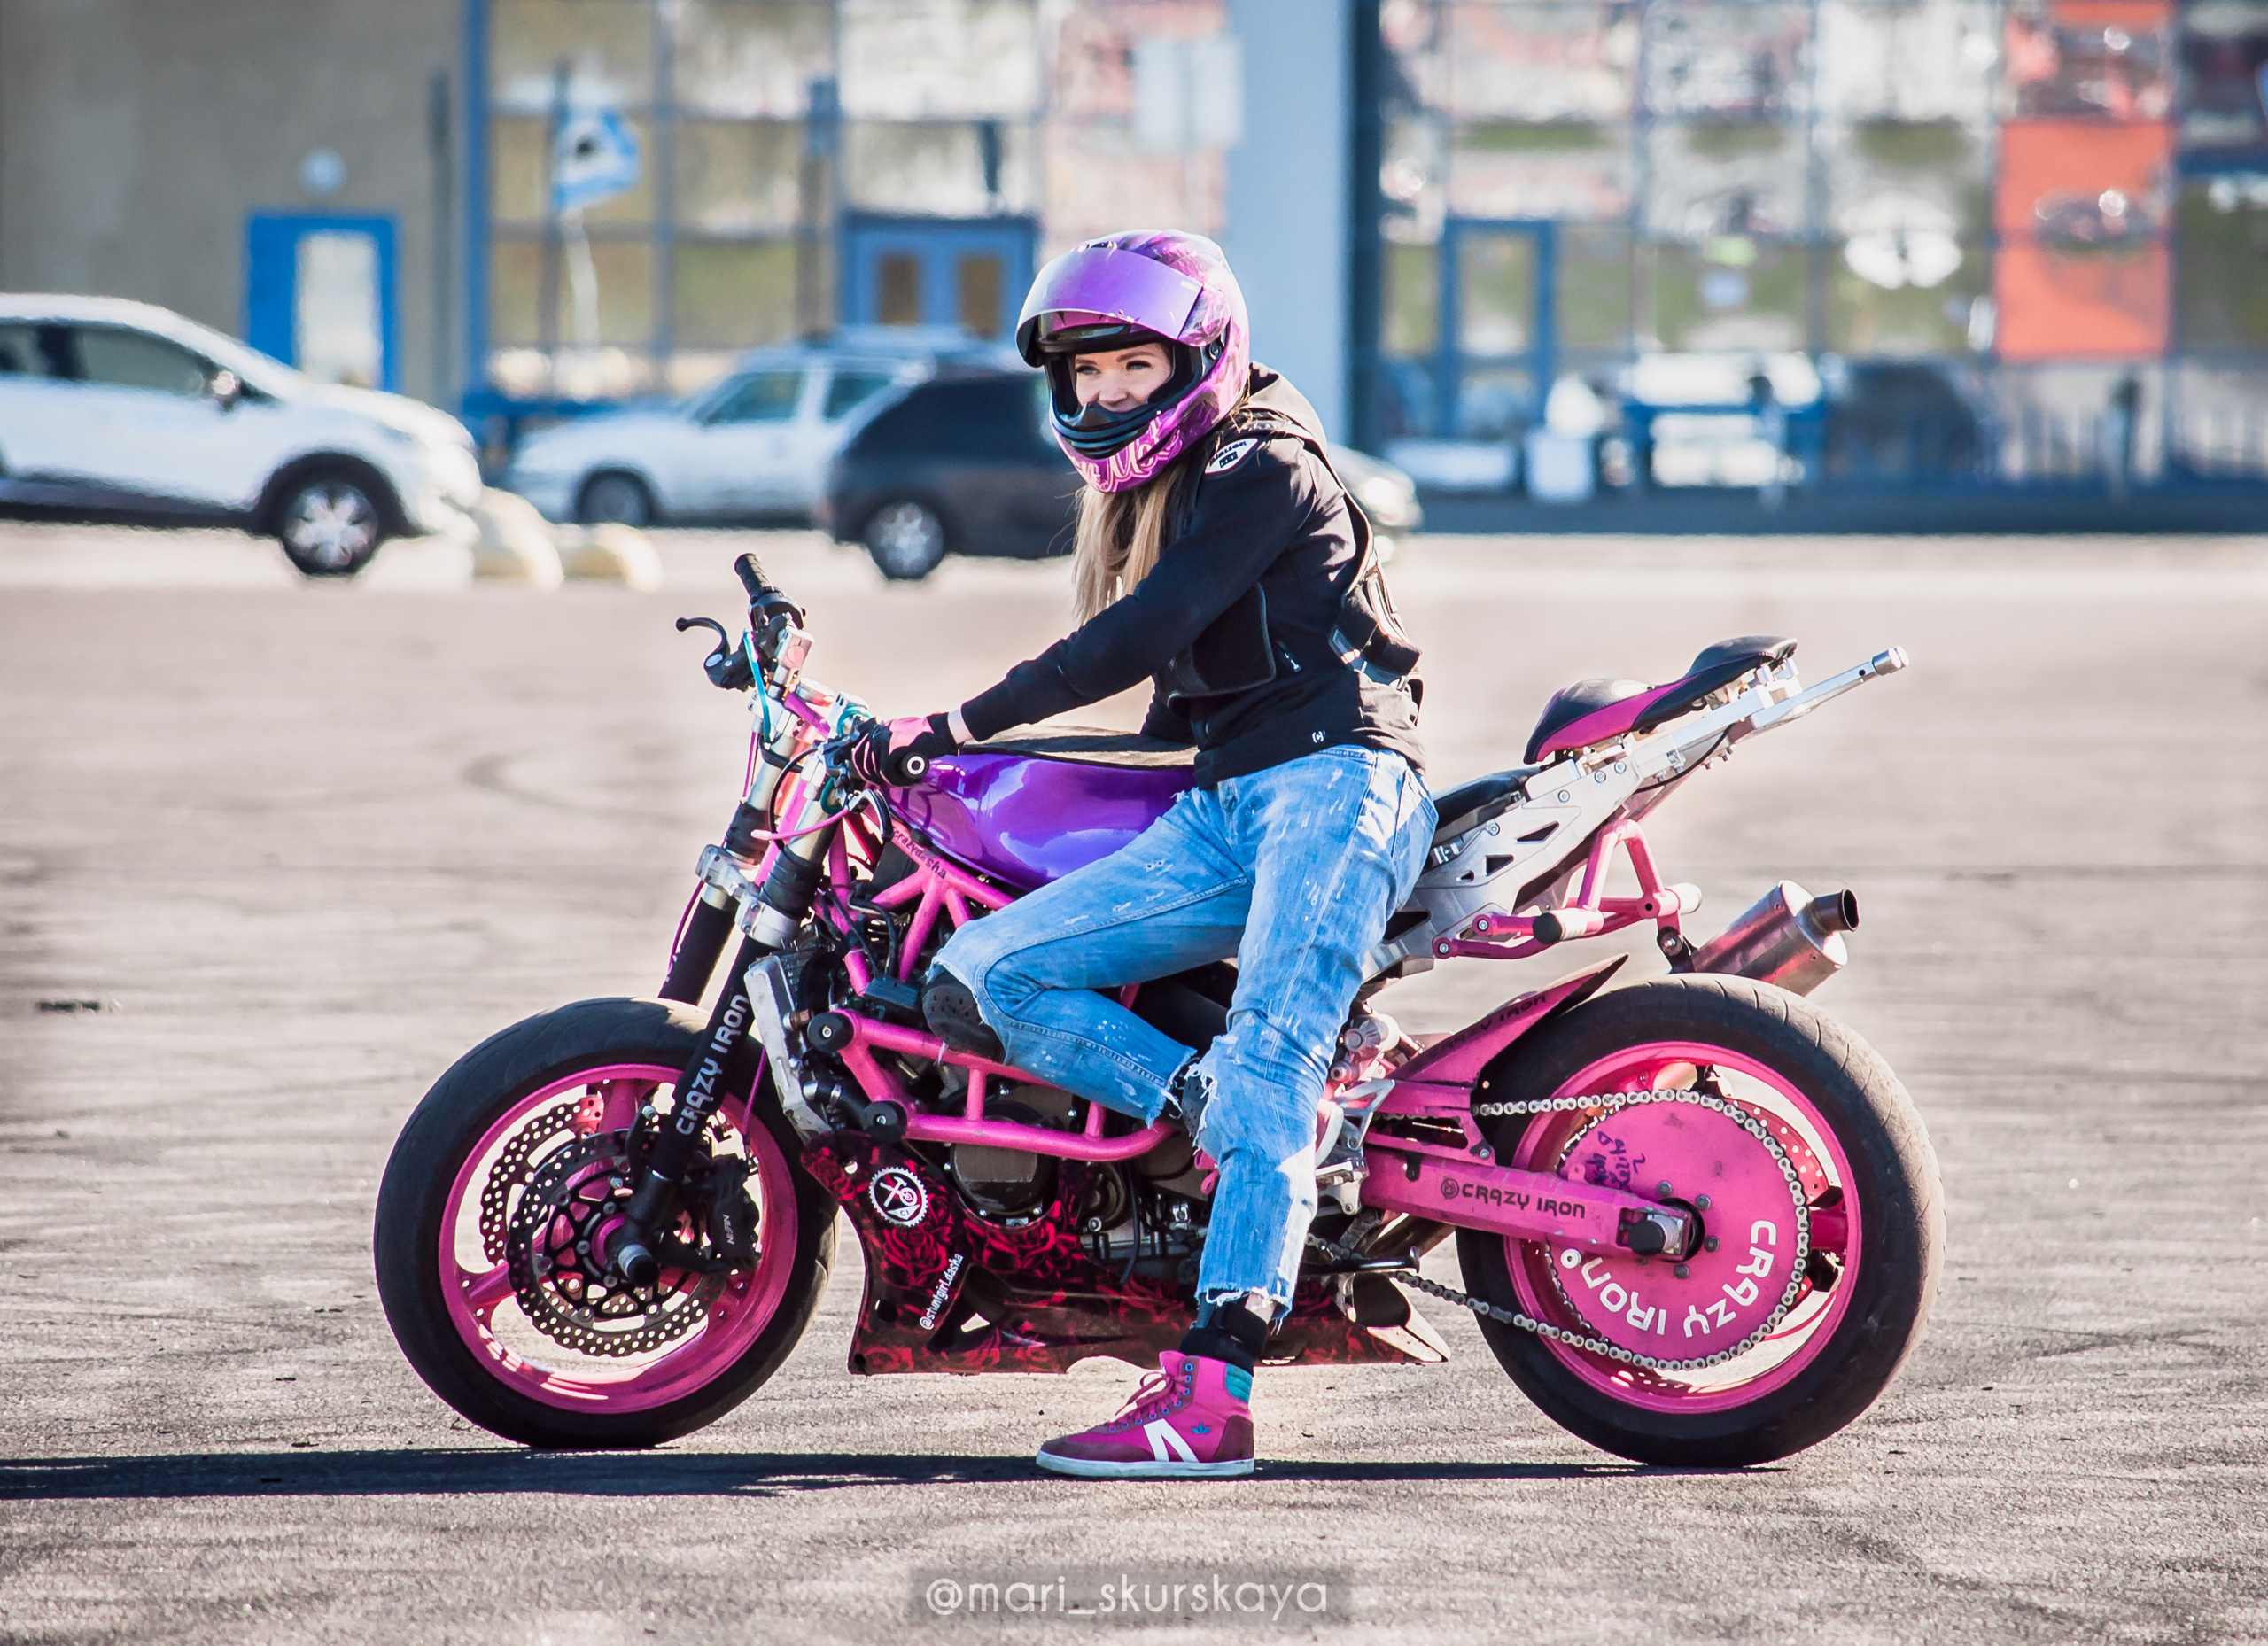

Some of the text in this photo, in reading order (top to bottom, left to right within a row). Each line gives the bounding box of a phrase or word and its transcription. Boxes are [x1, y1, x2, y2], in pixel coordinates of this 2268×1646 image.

[676, 994, 750, 1136] CRAZY IRON
[1462, 1183, 1586, 1219] CRAZY IRON
[1581, 1220, 1777, 1338] CRAZY IRON
